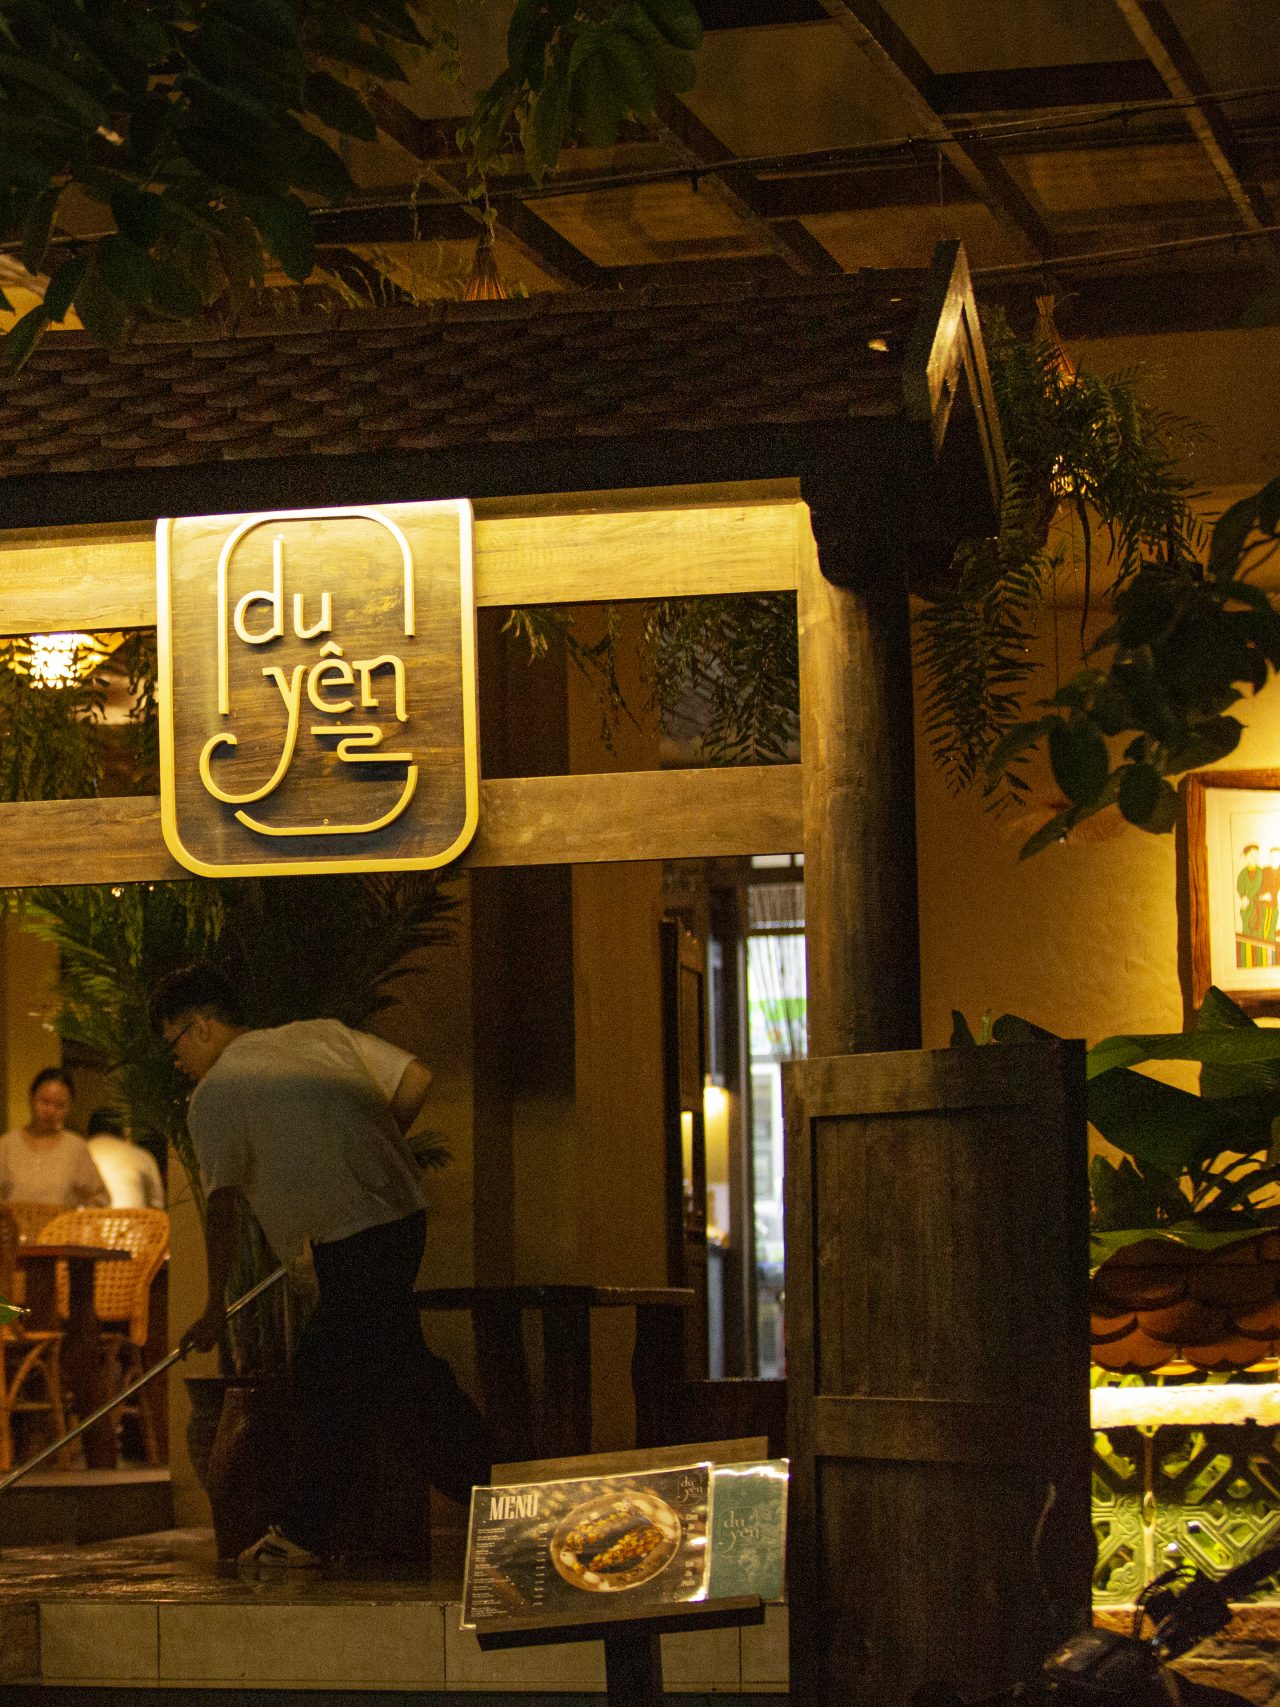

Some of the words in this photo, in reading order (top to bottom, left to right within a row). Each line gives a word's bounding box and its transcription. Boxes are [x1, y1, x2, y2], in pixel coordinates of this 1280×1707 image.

[233, 533, 332, 645] du
[198, 640, 410, 805] yên
[489, 1494, 539, 1521] MENU
[723, 1510, 745, 1528] du
